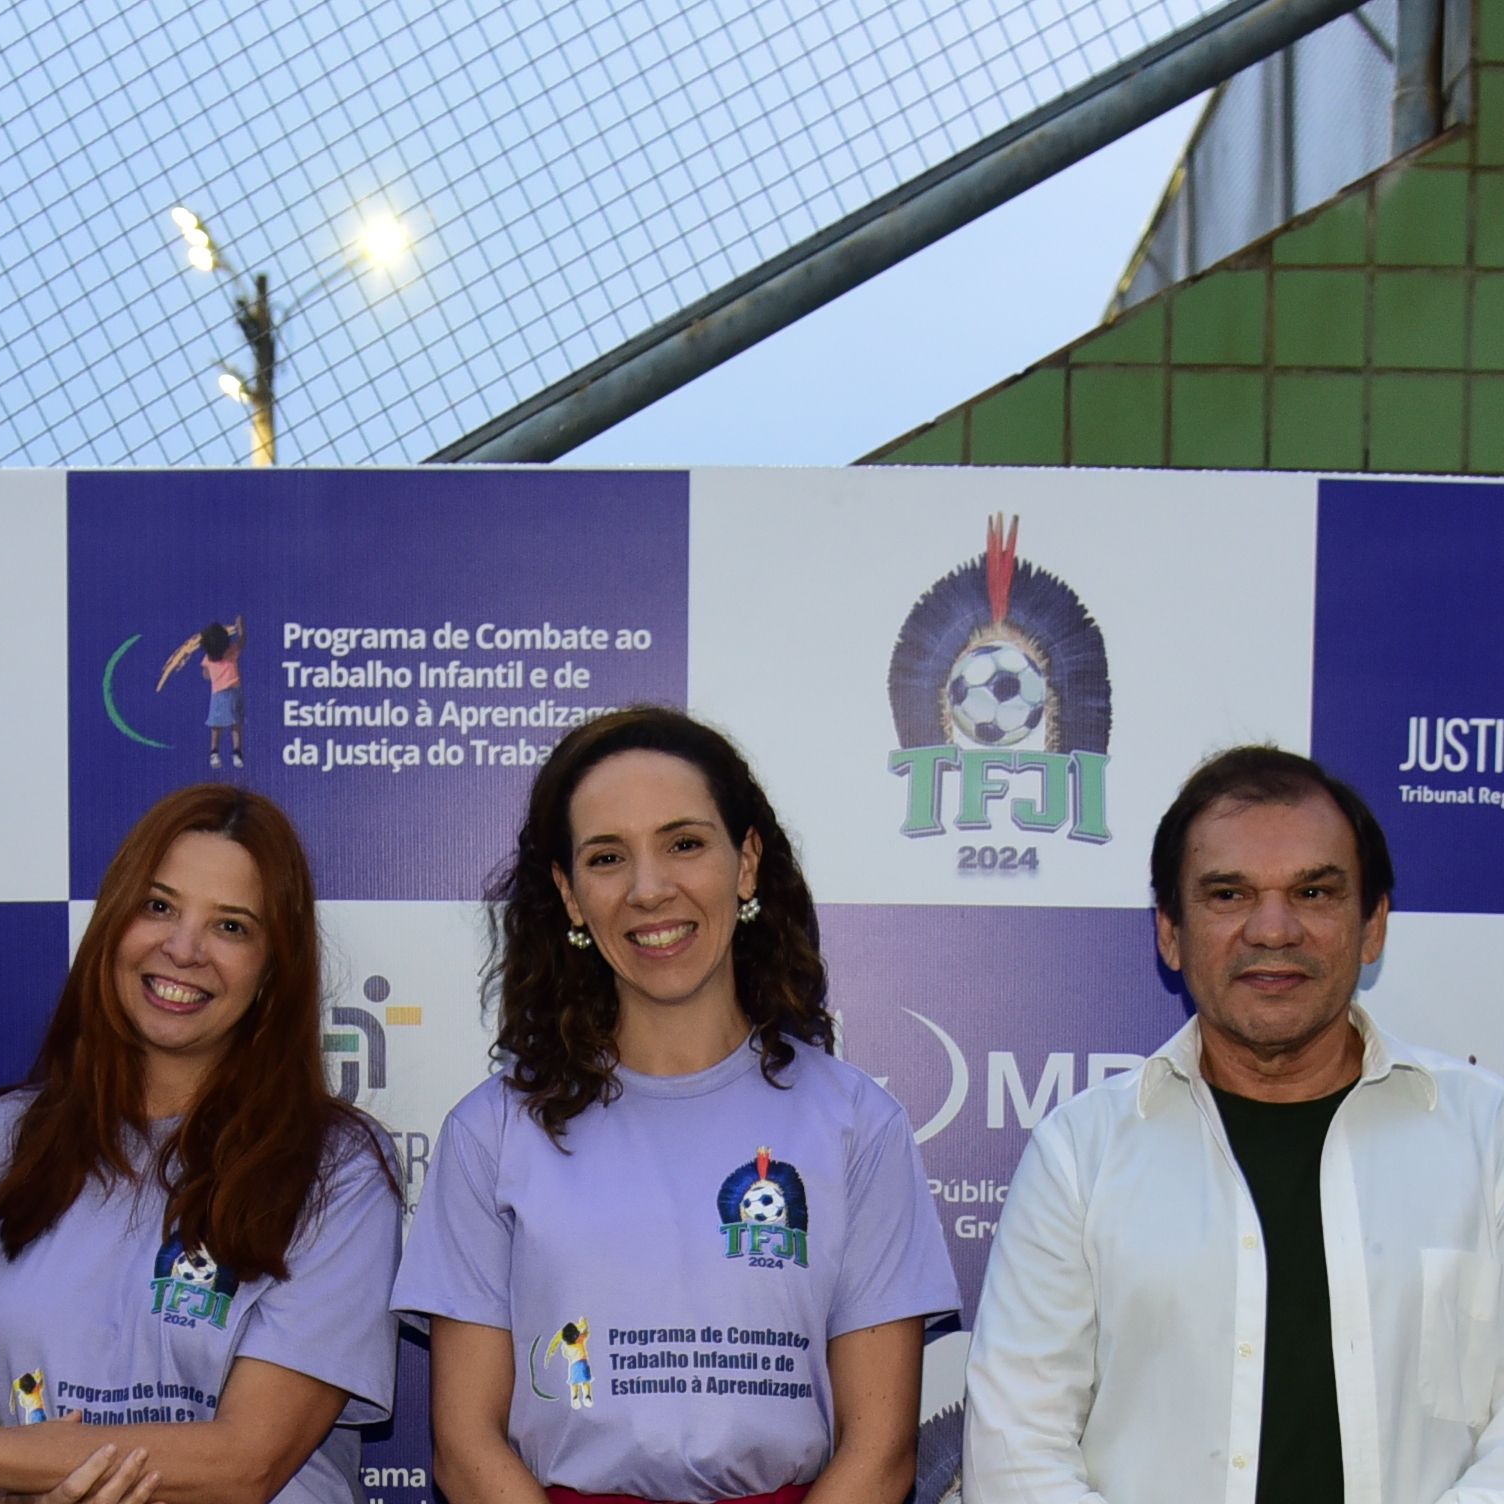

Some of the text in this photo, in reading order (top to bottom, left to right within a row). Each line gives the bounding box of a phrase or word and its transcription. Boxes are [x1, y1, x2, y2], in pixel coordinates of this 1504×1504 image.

[283, 621, 651, 655] Programa de Combate ao
[282, 660, 590, 688] Trabalho Infantil e de
[283, 698, 433, 727] Estímulo à
[283, 740, 464, 772] da Justiça do
[888, 744, 1113, 845] TFJI
[1399, 785, 1474, 804] Tribunal
[957, 846, 1038, 870] 2024
[927, 1179, 1009, 1203] Públic
[719, 1222, 809, 1268] TFJI
[749, 1257, 783, 1269] 2024
[150, 1277, 233, 1330] TFJI
[163, 1313, 195, 1328] 2024
[609, 1326, 722, 1345] Programa de
[610, 1351, 794, 1372] Trabalho Infantil e de
[58, 1381, 153, 1403] Programa de
[611, 1376, 686, 1395] Estímulo
[692, 1376, 701, 1394] à
